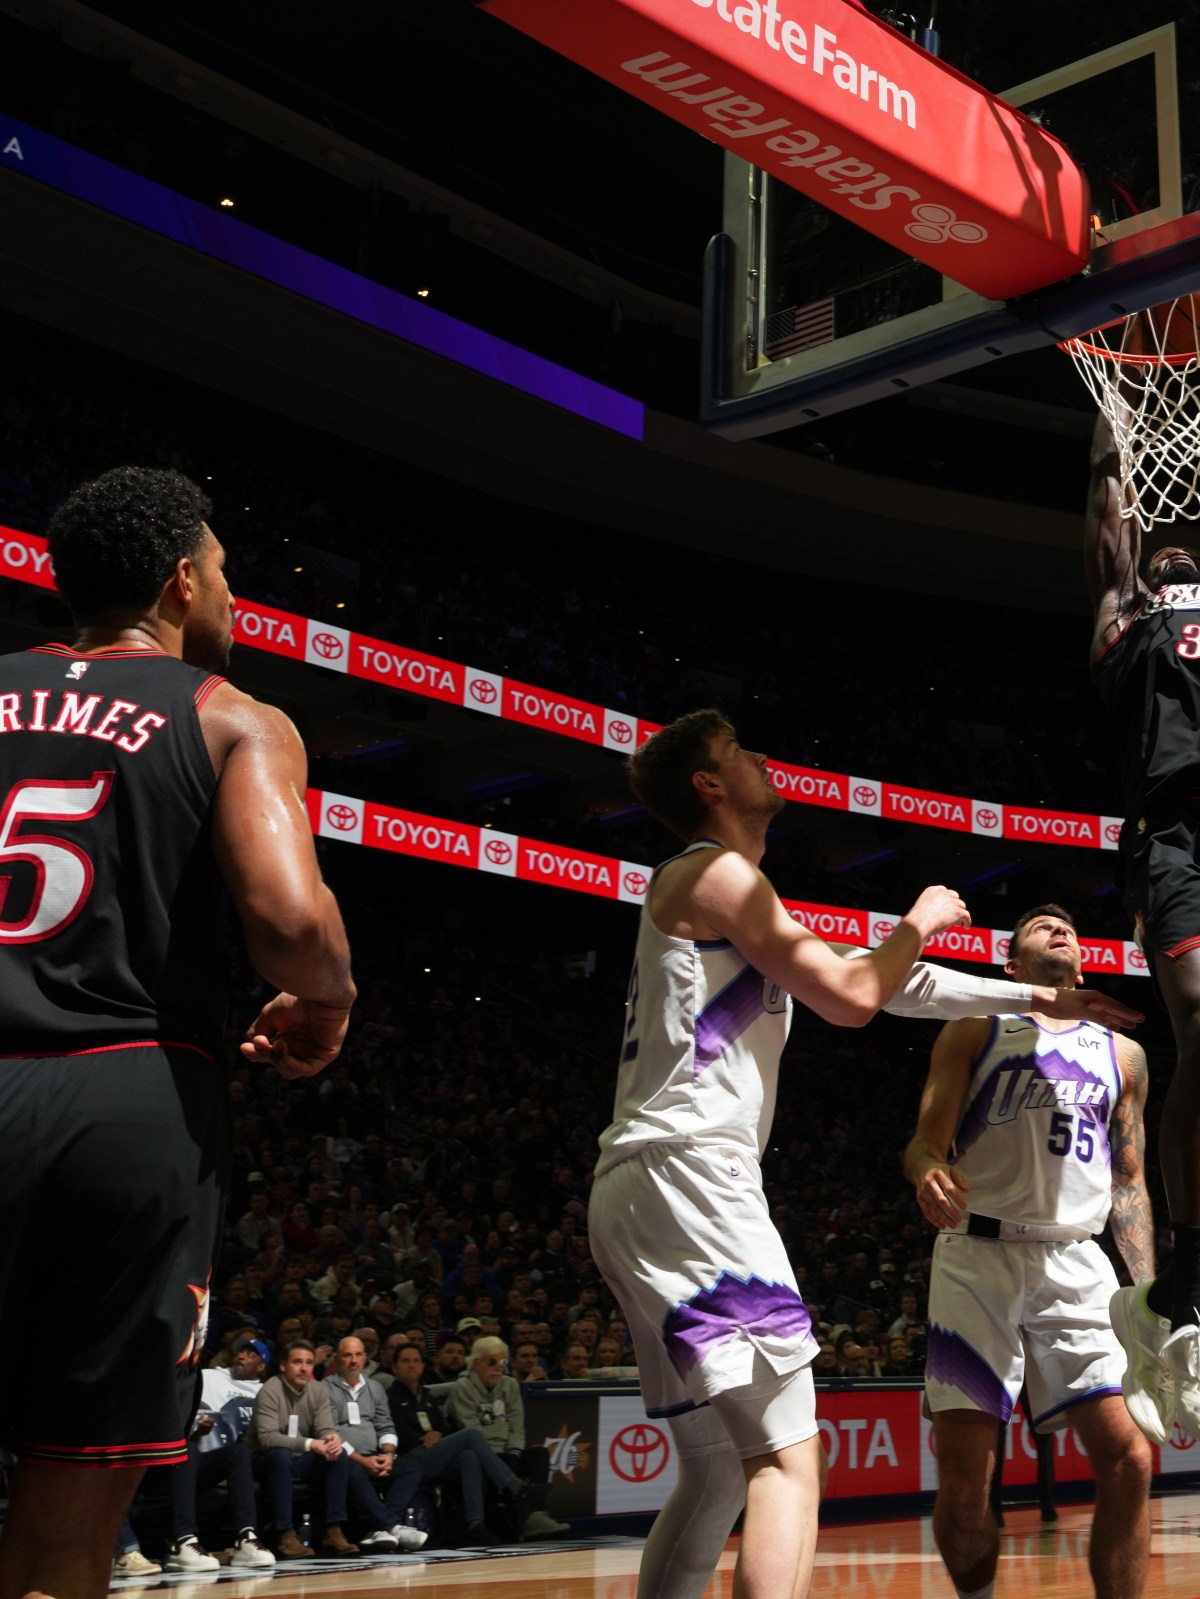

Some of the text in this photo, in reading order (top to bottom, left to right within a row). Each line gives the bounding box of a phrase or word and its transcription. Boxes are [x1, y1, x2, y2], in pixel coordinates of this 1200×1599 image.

[620, 49, 921, 212] StateFarm
[359, 646, 455, 692] TOYOTA
[511, 691, 595, 733] TOYOTA
[889, 793, 965, 822] TOYOTA
[1011, 815, 1092, 838] TOYOTA
[0, 770, 116, 945] 5
[374, 815, 470, 856] TOYOTA
[526, 850, 611, 886] TOYOTA
[986, 1068, 1110, 1126] UTAH
[1047, 1111, 1096, 1164] 55
